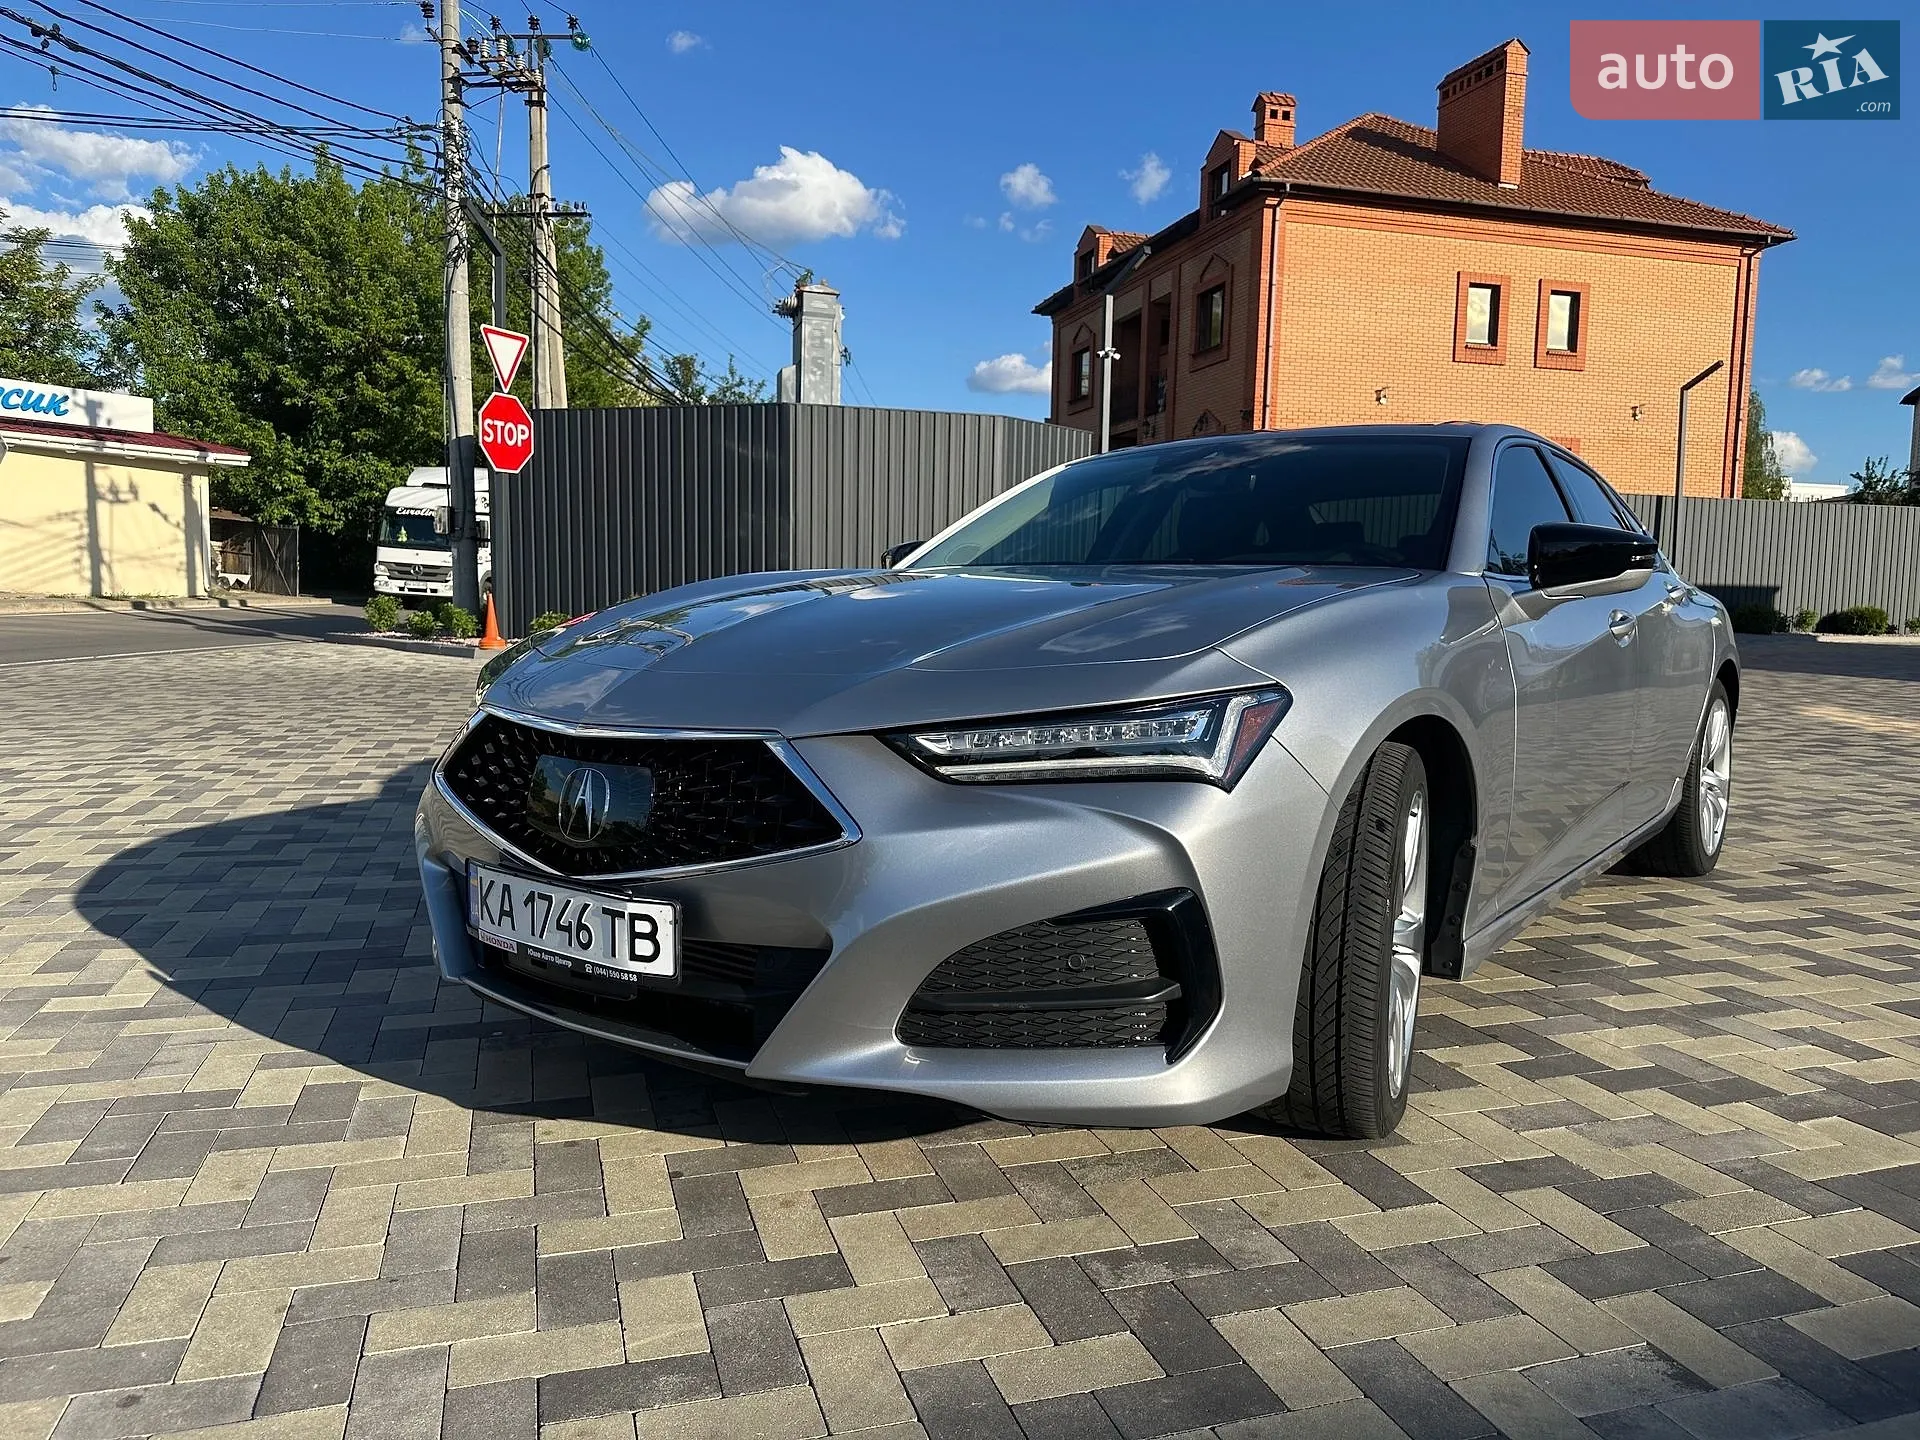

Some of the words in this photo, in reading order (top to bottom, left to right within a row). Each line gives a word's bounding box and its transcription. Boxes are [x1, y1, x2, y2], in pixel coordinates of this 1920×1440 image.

[483, 417, 530, 447] STOP
[396, 507, 437, 516] Eurolin
[479, 875, 516, 931] KA
[523, 890, 594, 951] 1746
[601, 906, 661, 963] TB
[593, 966, 609, 978] (044)
[620, 972, 629, 981] 58
